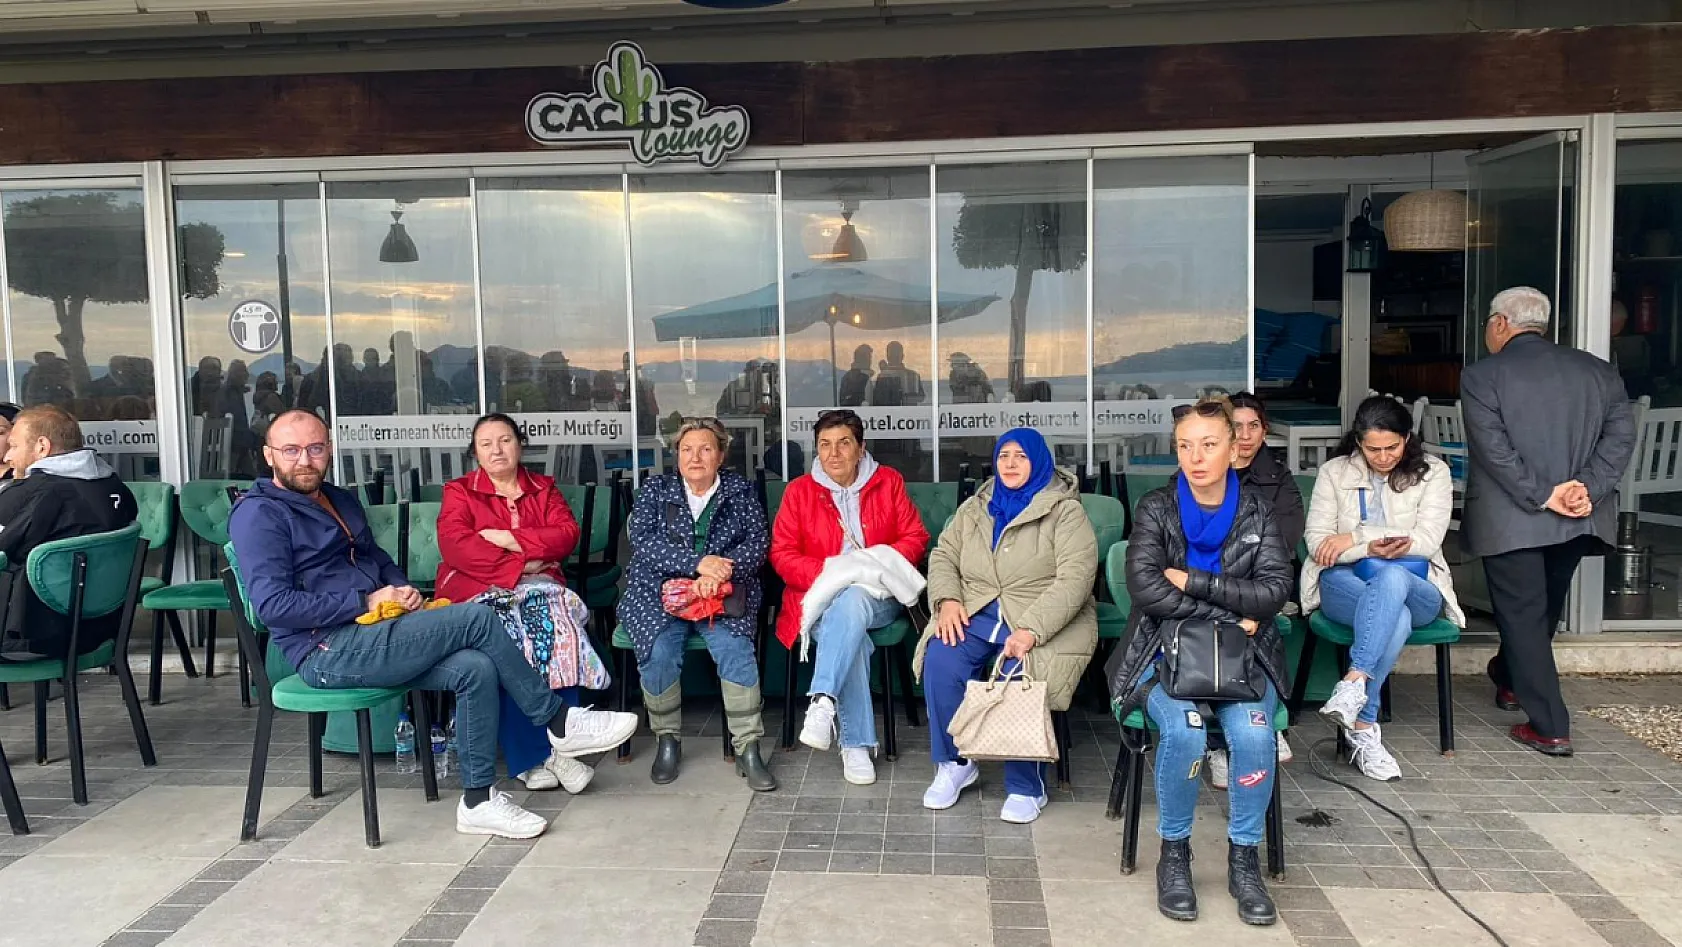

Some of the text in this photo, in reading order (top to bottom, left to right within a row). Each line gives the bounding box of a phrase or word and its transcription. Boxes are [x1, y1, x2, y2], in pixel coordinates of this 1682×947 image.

[538, 97, 694, 132] CACTUS
[640, 119, 739, 160] lounge
[519, 419, 623, 439] deniz Mutfağı
[939, 410, 1080, 429] Alacarte Restaurant
[339, 422, 472, 441] Mediterranean Kitche
